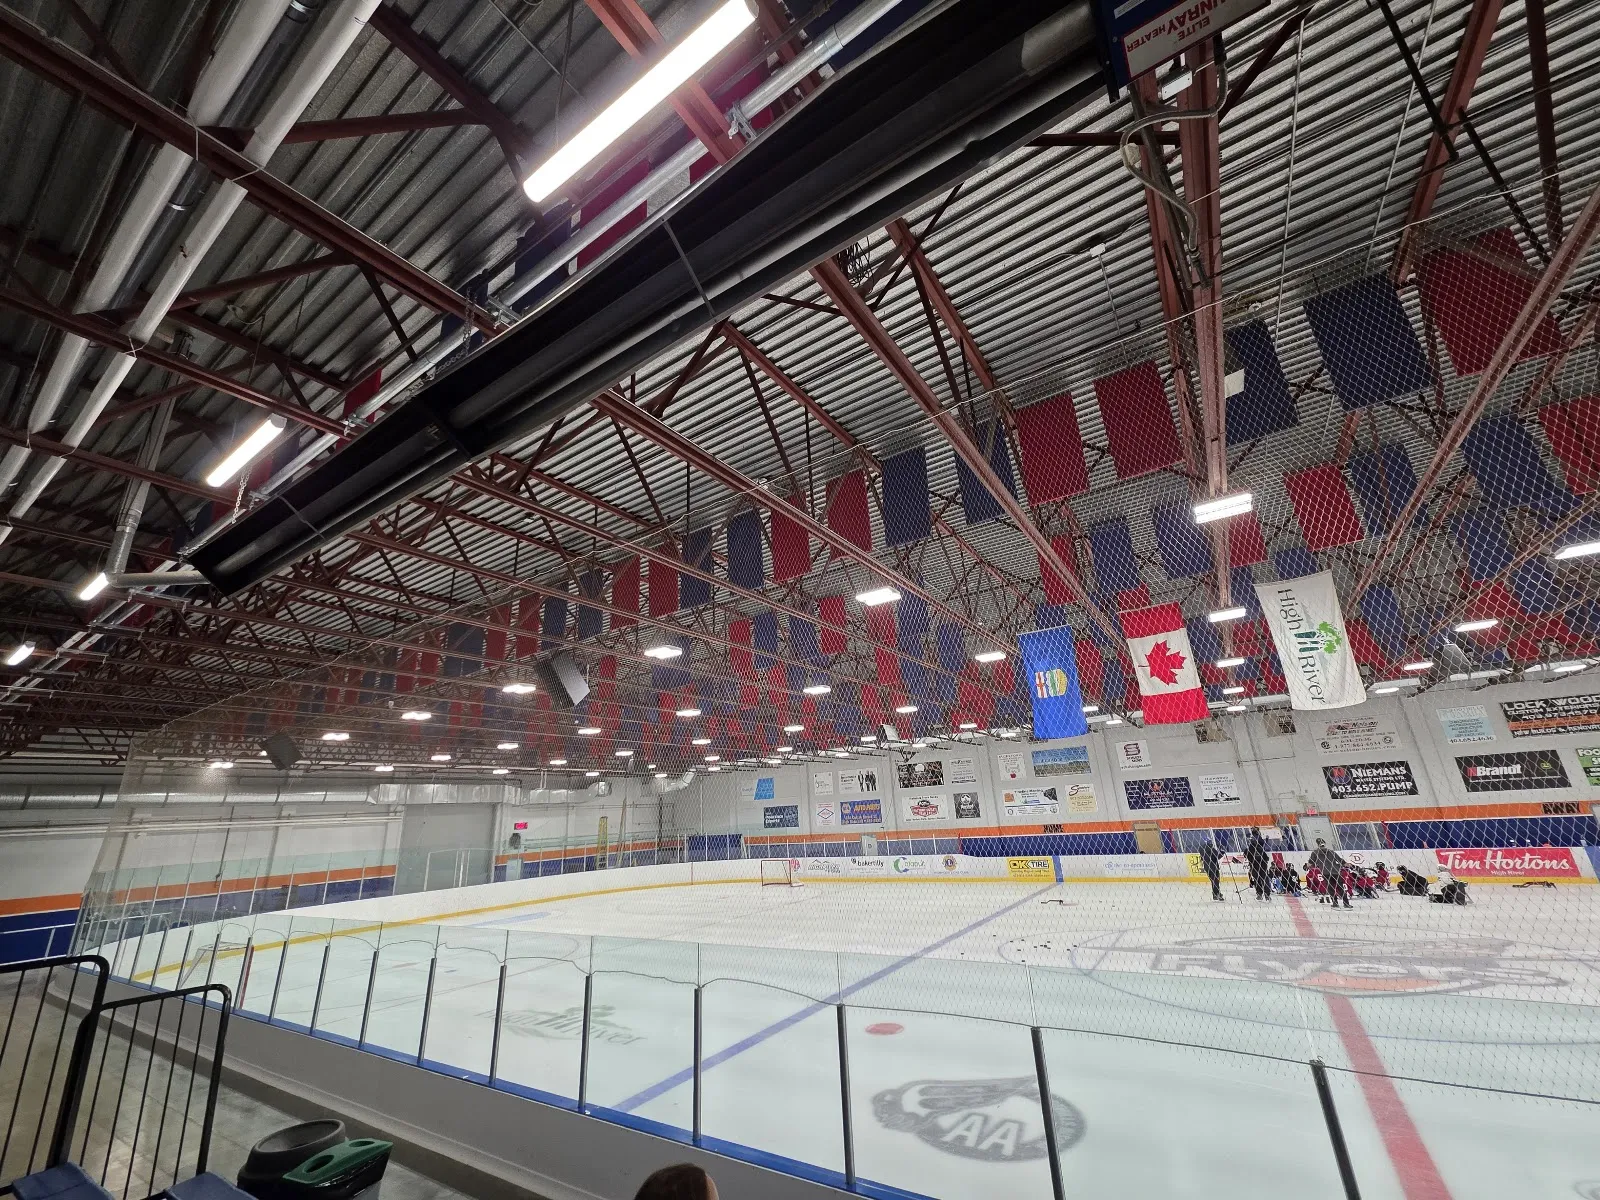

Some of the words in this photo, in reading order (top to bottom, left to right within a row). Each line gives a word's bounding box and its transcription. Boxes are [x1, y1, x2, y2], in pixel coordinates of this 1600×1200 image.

[1177, 15, 1211, 42] ELITE
[1127, 23, 1166, 53] HEATER
[1277, 588, 1303, 631] High
[1297, 655, 1327, 703] River
[1504, 700, 1547, 711] LOCK
[1507, 708, 1544, 716] CUSTOM
[1546, 702, 1600, 712] EXTERIORS
[1350, 766, 1407, 778] NIEMANS
[1476, 763, 1522, 777] Brandt
[1541, 801, 1581, 815] AWAY
[1439, 850, 1482, 870] Tim
[1483, 849, 1570, 870] Hortons
[939, 1112, 1021, 1156] AA
